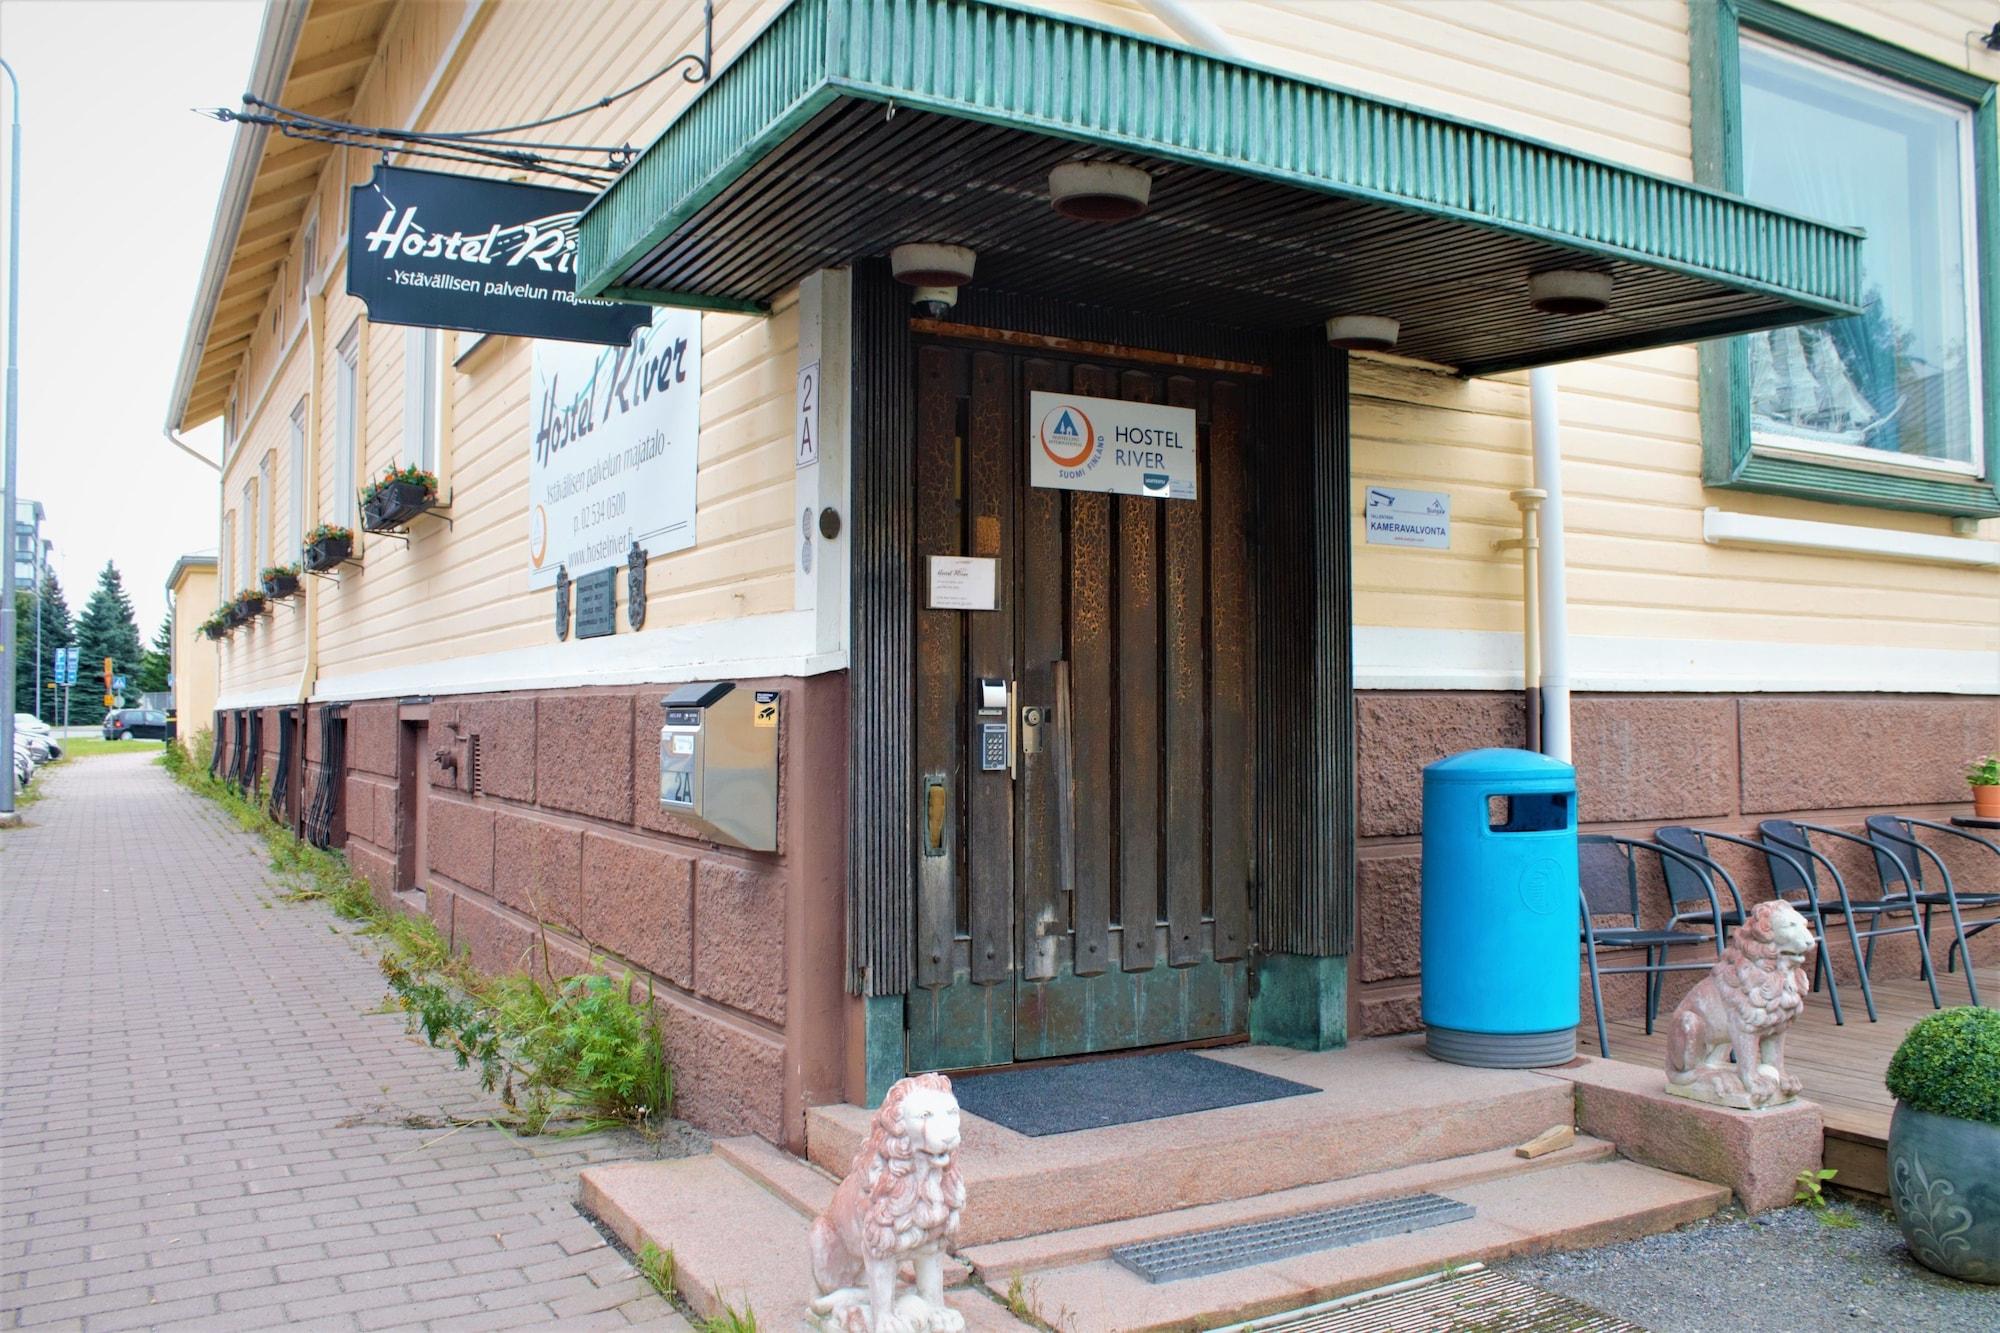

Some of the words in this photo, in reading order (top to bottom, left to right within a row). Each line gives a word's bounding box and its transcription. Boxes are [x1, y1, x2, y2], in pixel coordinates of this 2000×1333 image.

[365, 205, 502, 265] Hostel
[484, 279, 548, 302] palvelun
[536, 356, 600, 469] Hostel
[602, 332, 687, 425] River
[1058, 467, 1086, 479] SUOMI
[1087, 435, 1105, 471] FINLAND
[1115, 425, 1183, 449] HOSTEL
[586, 452, 621, 493] palvelun
[623, 431, 665, 472] majatalo
[1115, 449, 1166, 470] RIVER
[581, 505, 590, 530] 02
[592, 498, 605, 527] 534
[607, 490, 626, 521] 0500
[1370, 521, 1447, 536] KAMERAVALVONTA
